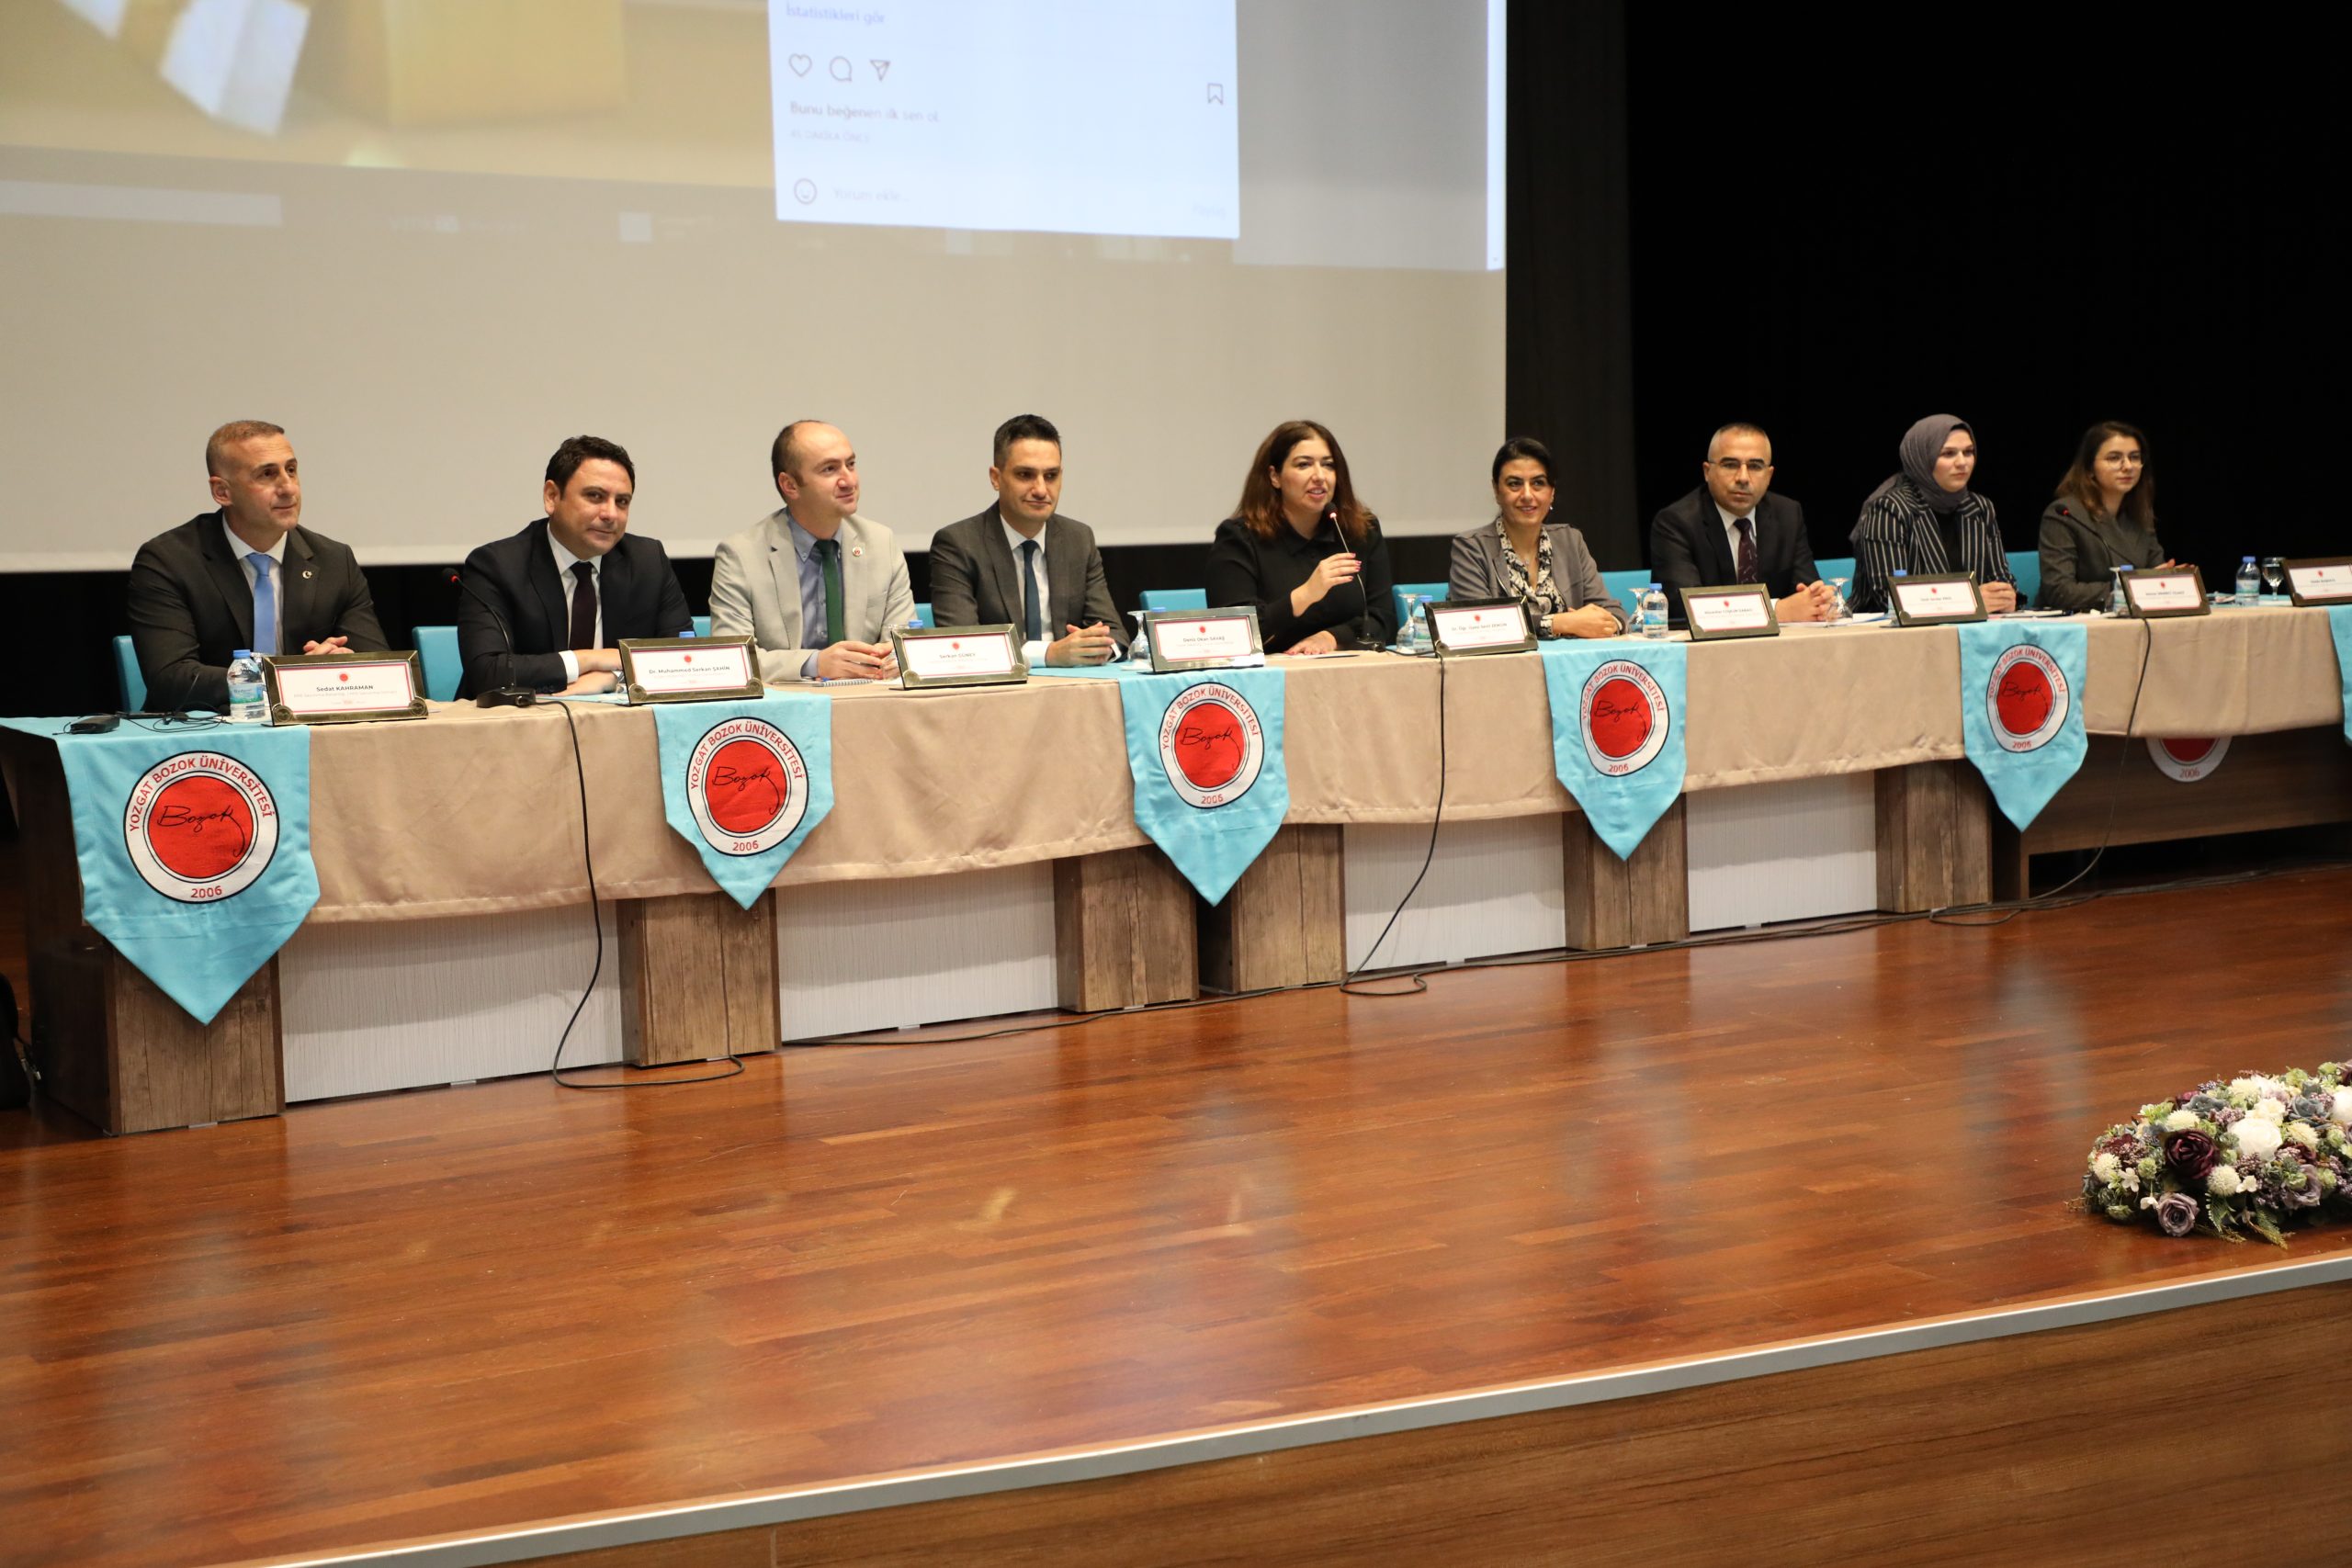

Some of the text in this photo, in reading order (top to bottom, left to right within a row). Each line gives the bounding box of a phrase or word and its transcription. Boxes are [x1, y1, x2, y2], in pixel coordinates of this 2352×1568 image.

[790, 101, 823, 116] Bunu
[1594, 664, 1618, 682] BOZOK
[1620, 663, 1665, 713] ÜNİVERSİTESİ
[1162, 685, 1261, 750] YOZGAT BOZOK ÜNİVERSİTESİ
[691, 720, 806, 790] YOZGAT BOZOK ÜNİVERSİTESİ
[1608, 763, 1629, 773] 2006
[130, 755, 276, 832] YOZGAT BOZOK ÜNİVERSİTESİ
[1201, 794, 1224, 805] 2006
[732, 840, 759, 852] 2006
[190, 885, 222, 898] 2006
